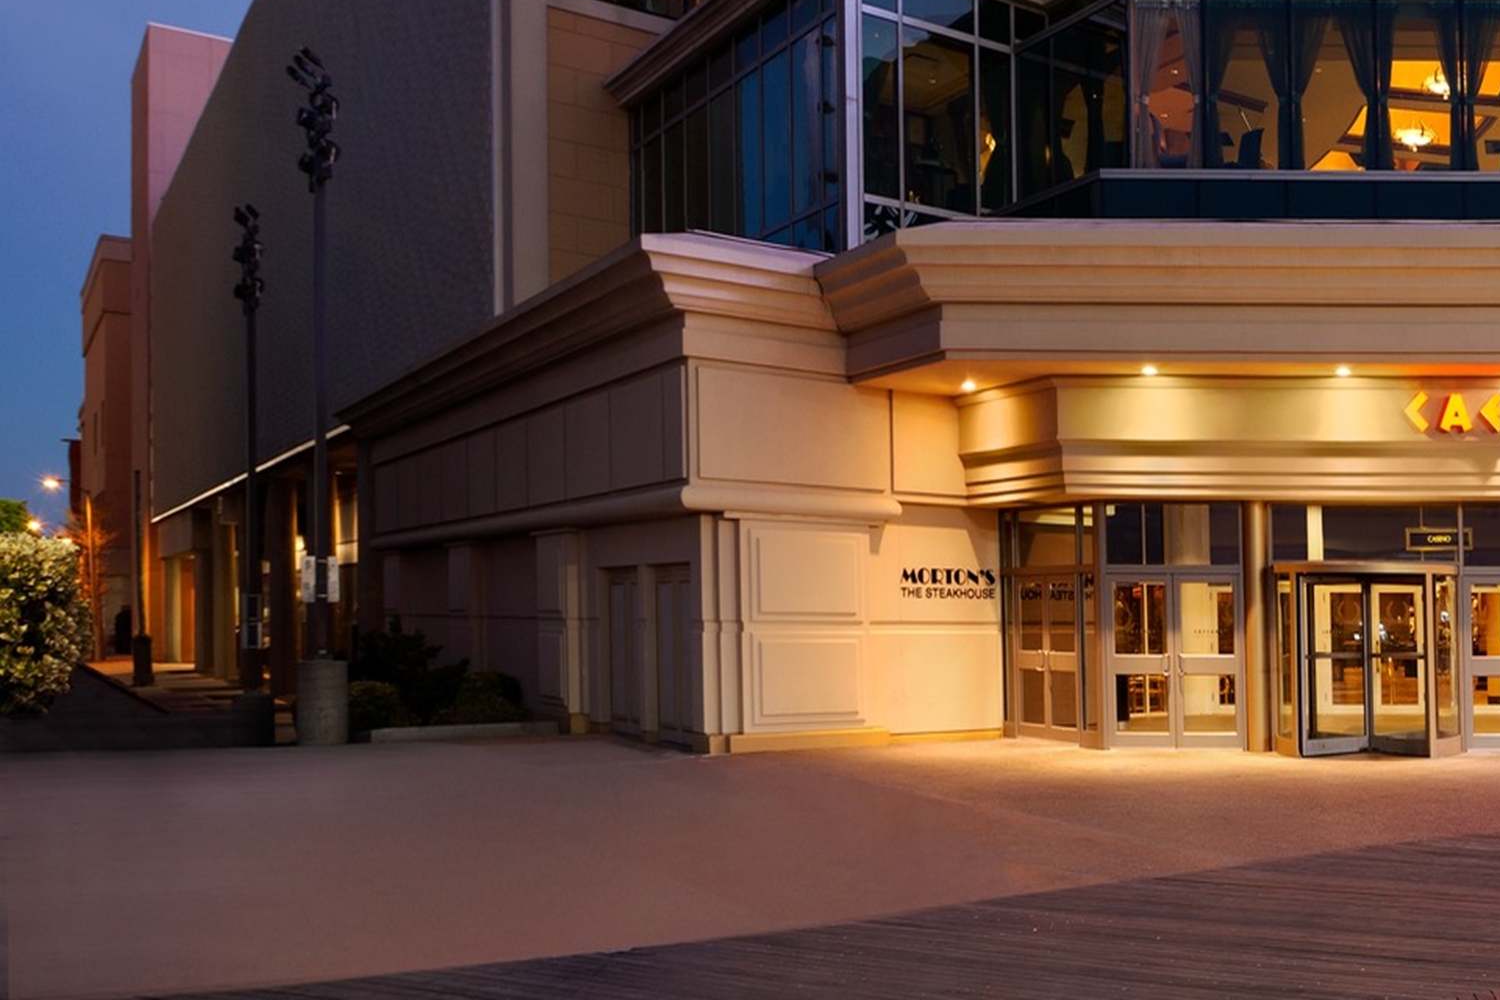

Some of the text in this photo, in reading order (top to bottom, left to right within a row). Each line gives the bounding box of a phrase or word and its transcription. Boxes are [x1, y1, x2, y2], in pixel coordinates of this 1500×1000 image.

[1427, 535, 1452, 543] CASINO
[900, 566, 996, 586] MORTON'S
[901, 587, 996, 600] THE STEAKHOUSE
